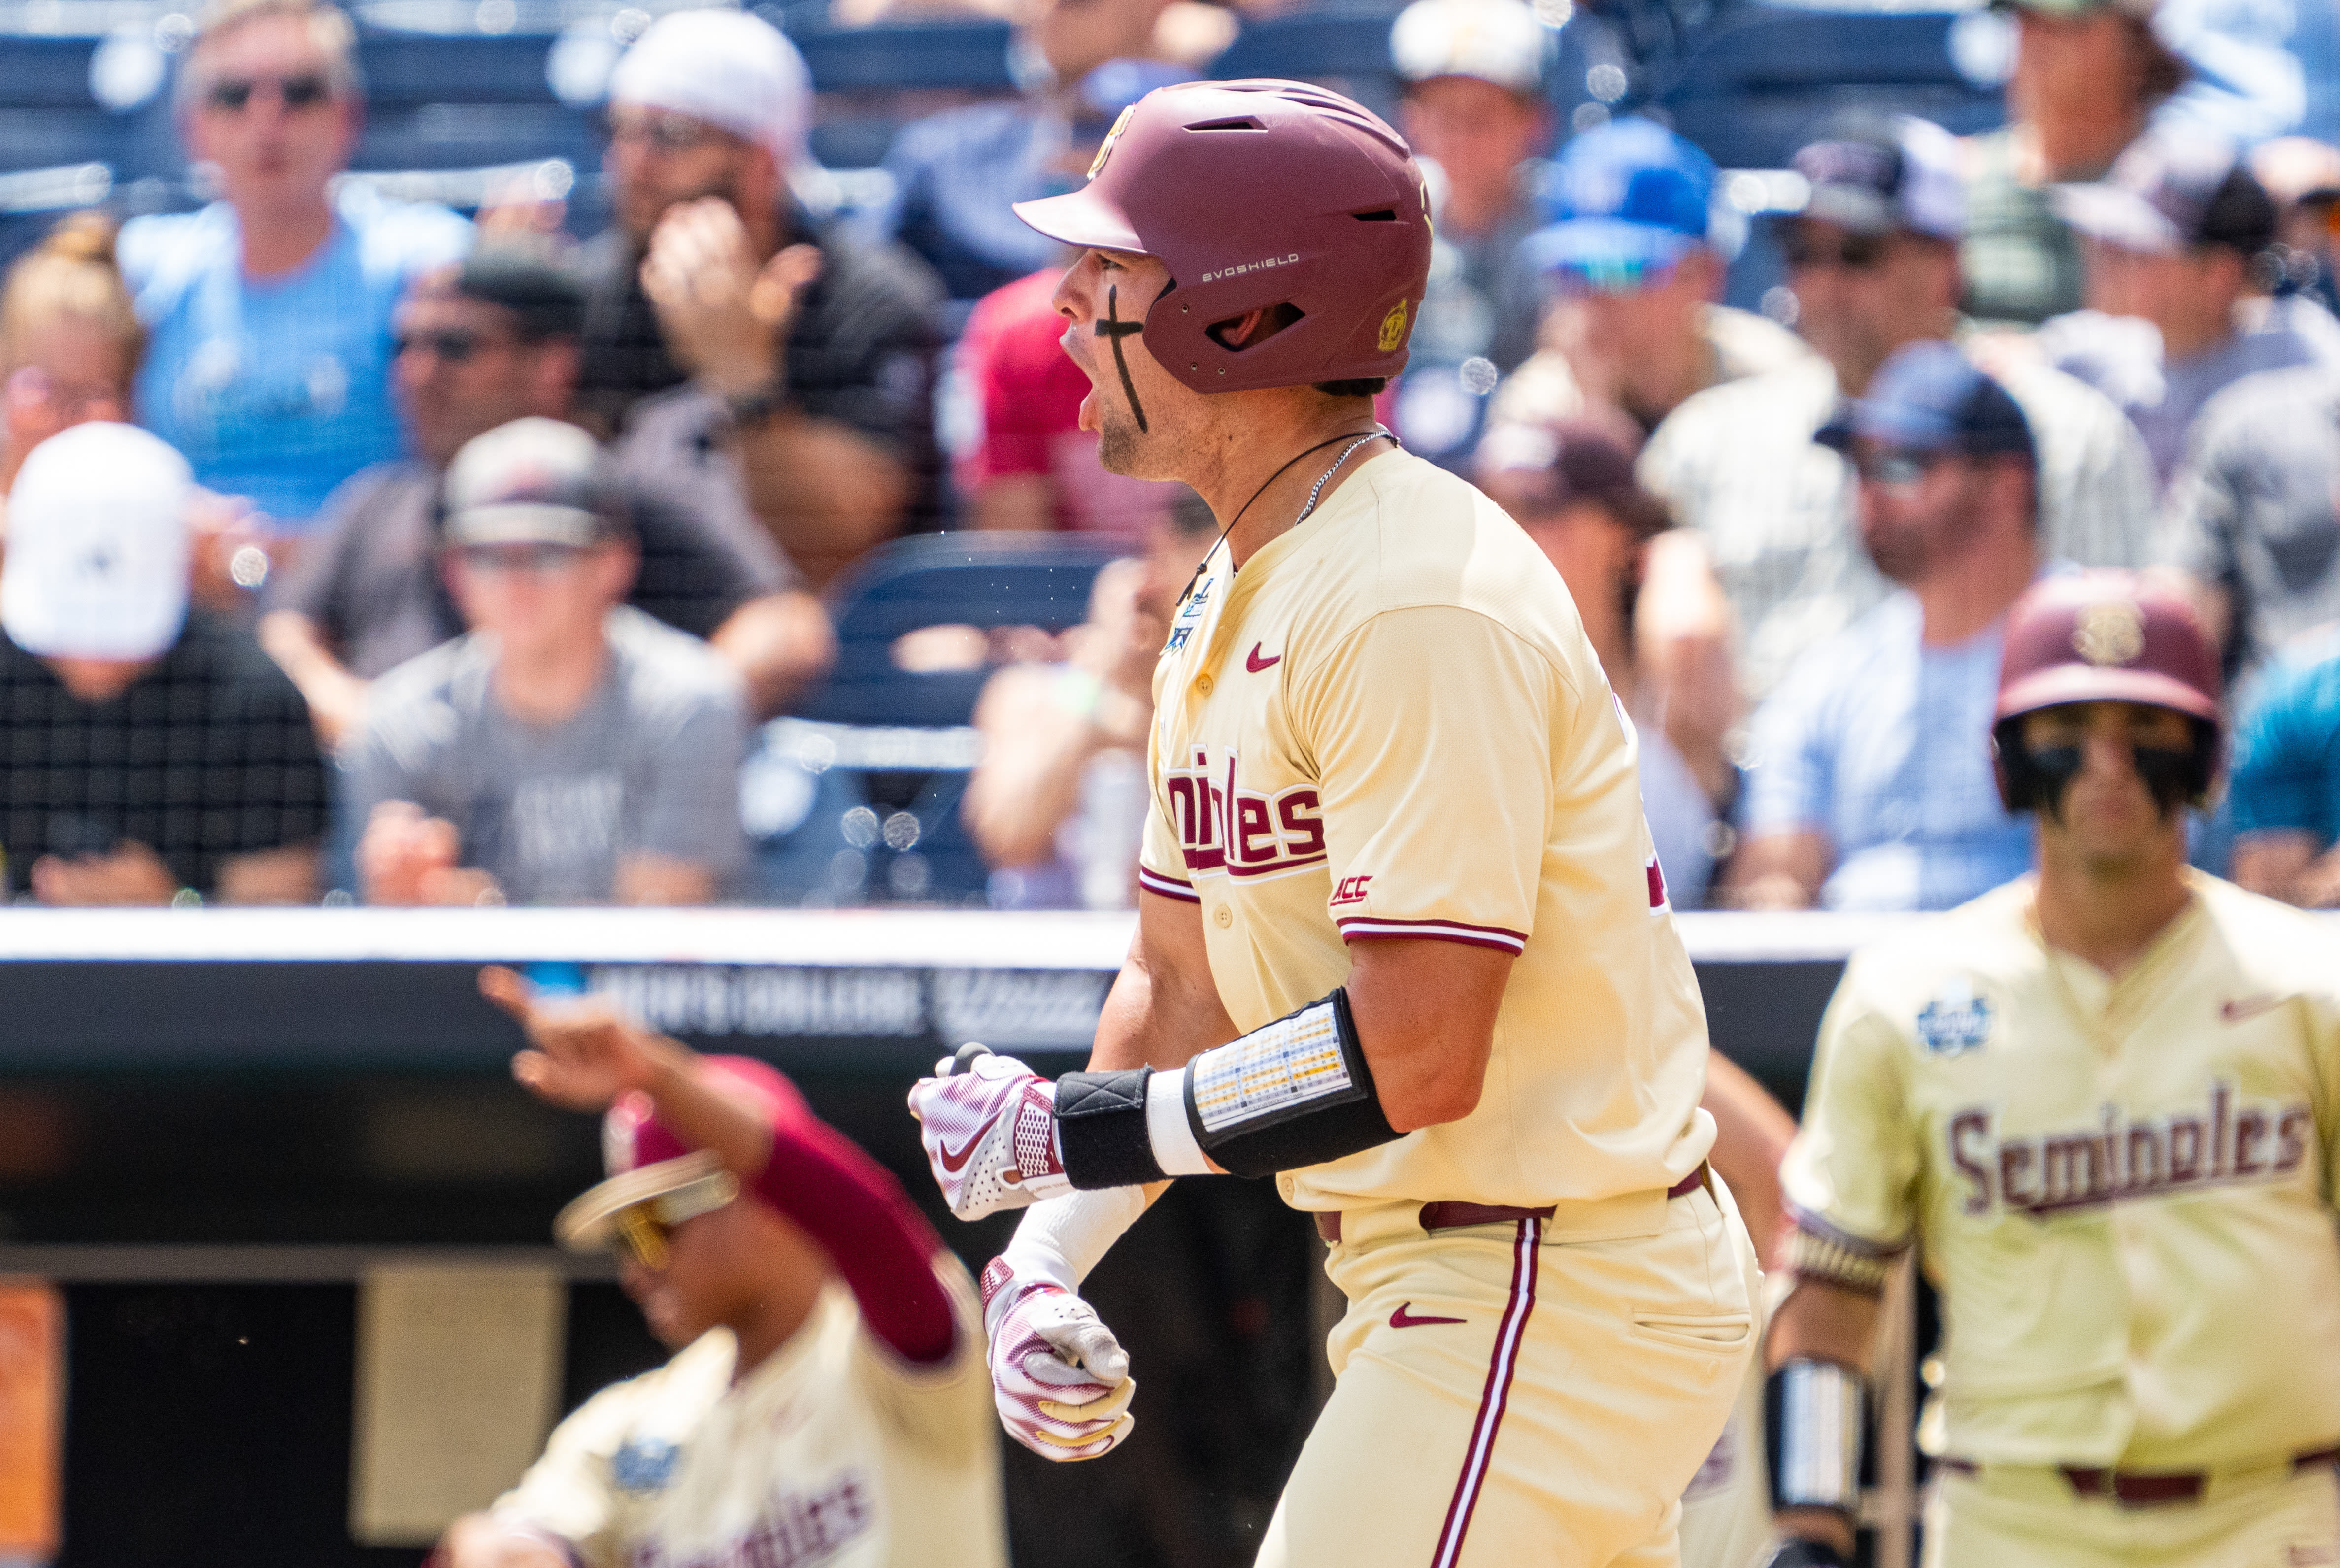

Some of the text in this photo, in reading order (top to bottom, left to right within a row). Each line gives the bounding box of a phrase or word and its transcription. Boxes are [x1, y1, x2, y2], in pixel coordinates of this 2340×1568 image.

[1202, 253, 1299, 282] EVOSHIELD
[1330, 875, 1373, 906] ACC
[1947, 1080, 2311, 1223] Seminoles
